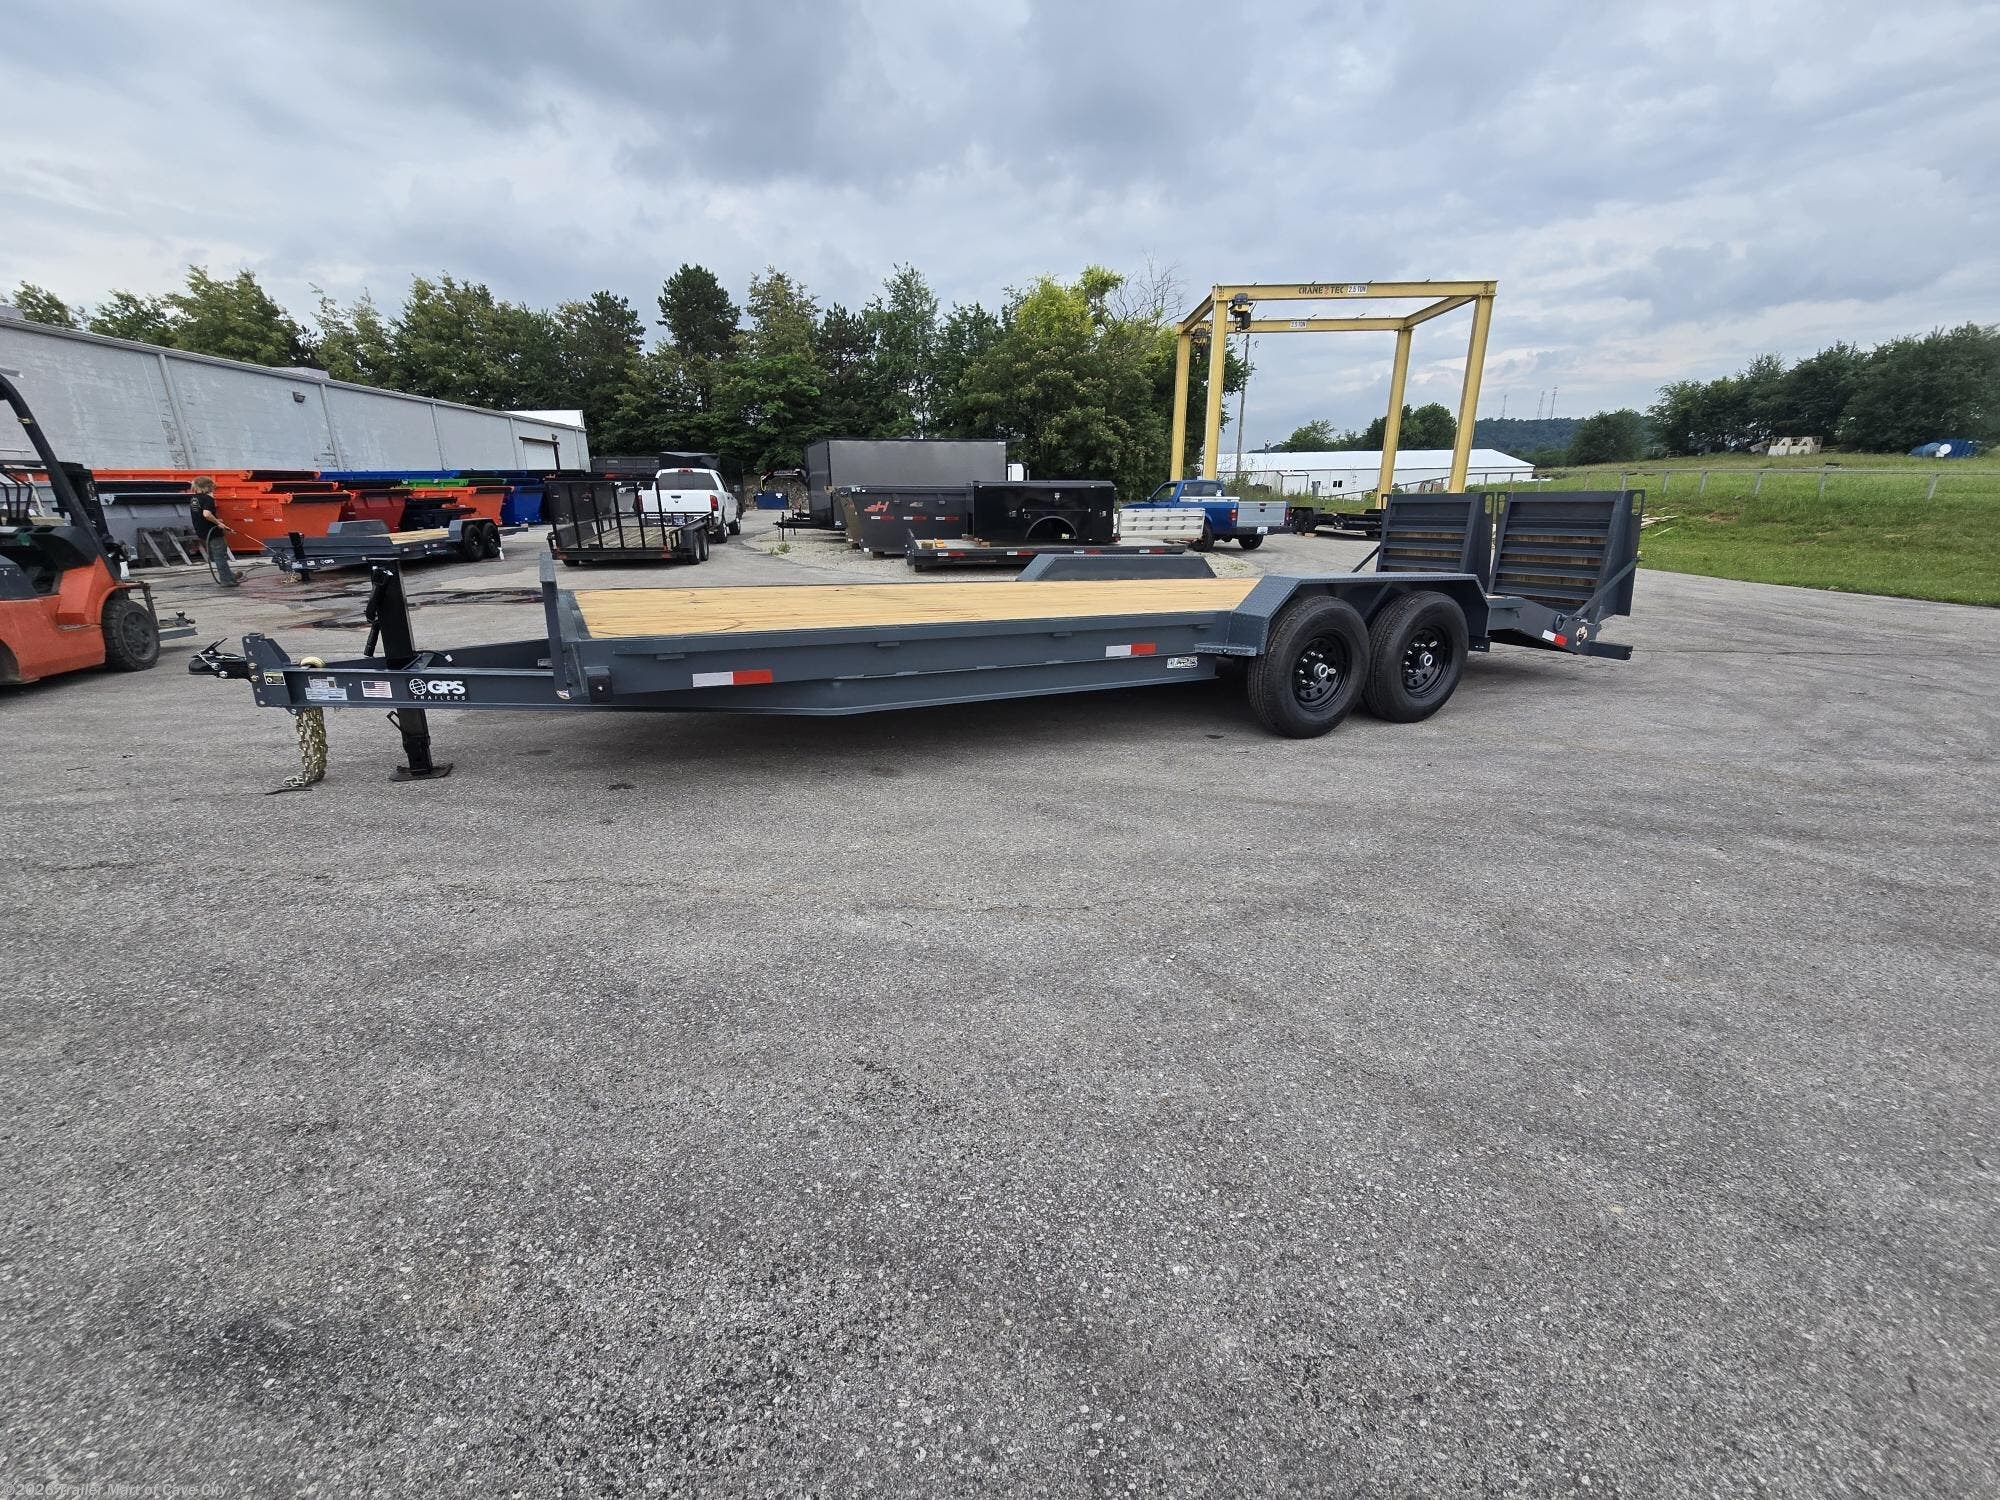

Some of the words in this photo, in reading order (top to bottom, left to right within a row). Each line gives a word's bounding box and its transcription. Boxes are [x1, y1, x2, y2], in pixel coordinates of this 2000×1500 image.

[1298, 286, 1323, 295] CRANE
[1330, 286, 1345, 294] TEC
[427, 680, 466, 695] GPS
